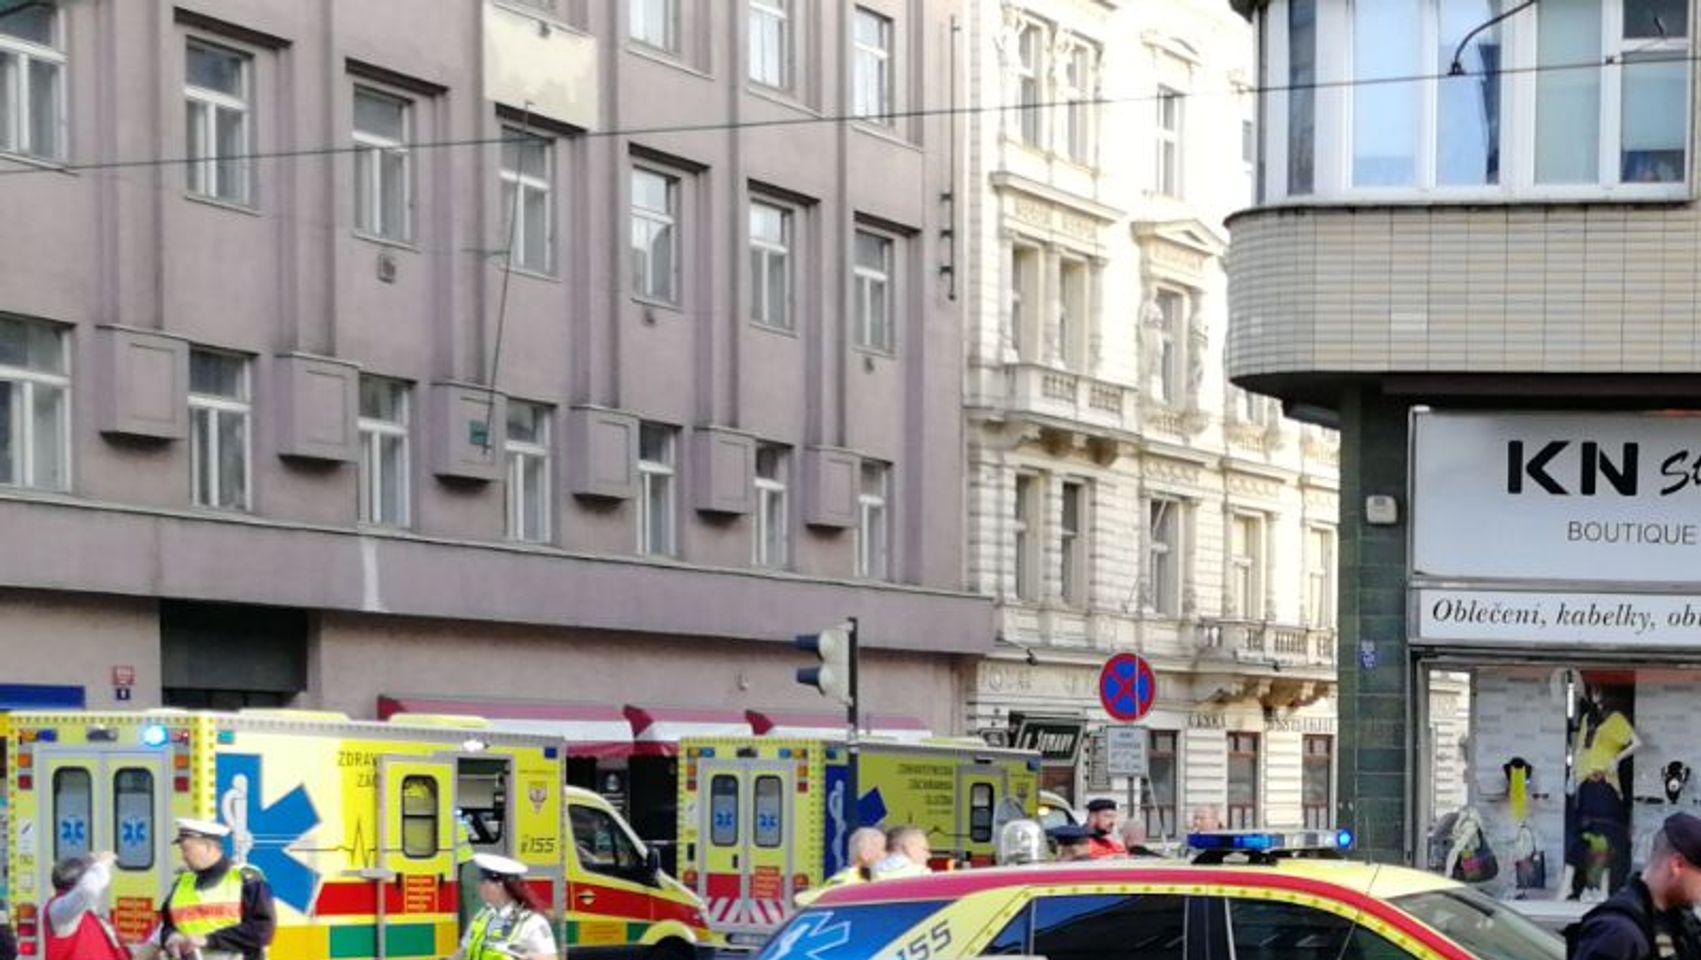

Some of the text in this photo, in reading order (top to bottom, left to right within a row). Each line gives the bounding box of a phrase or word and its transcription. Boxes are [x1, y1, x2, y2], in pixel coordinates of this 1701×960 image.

[1507, 440, 1640, 496] KN
[1567, 520, 1698, 546] BOUTIQUE
[1432, 599, 1547, 627] Oblečení,
[1556, 602, 1656, 632] kabelky,
